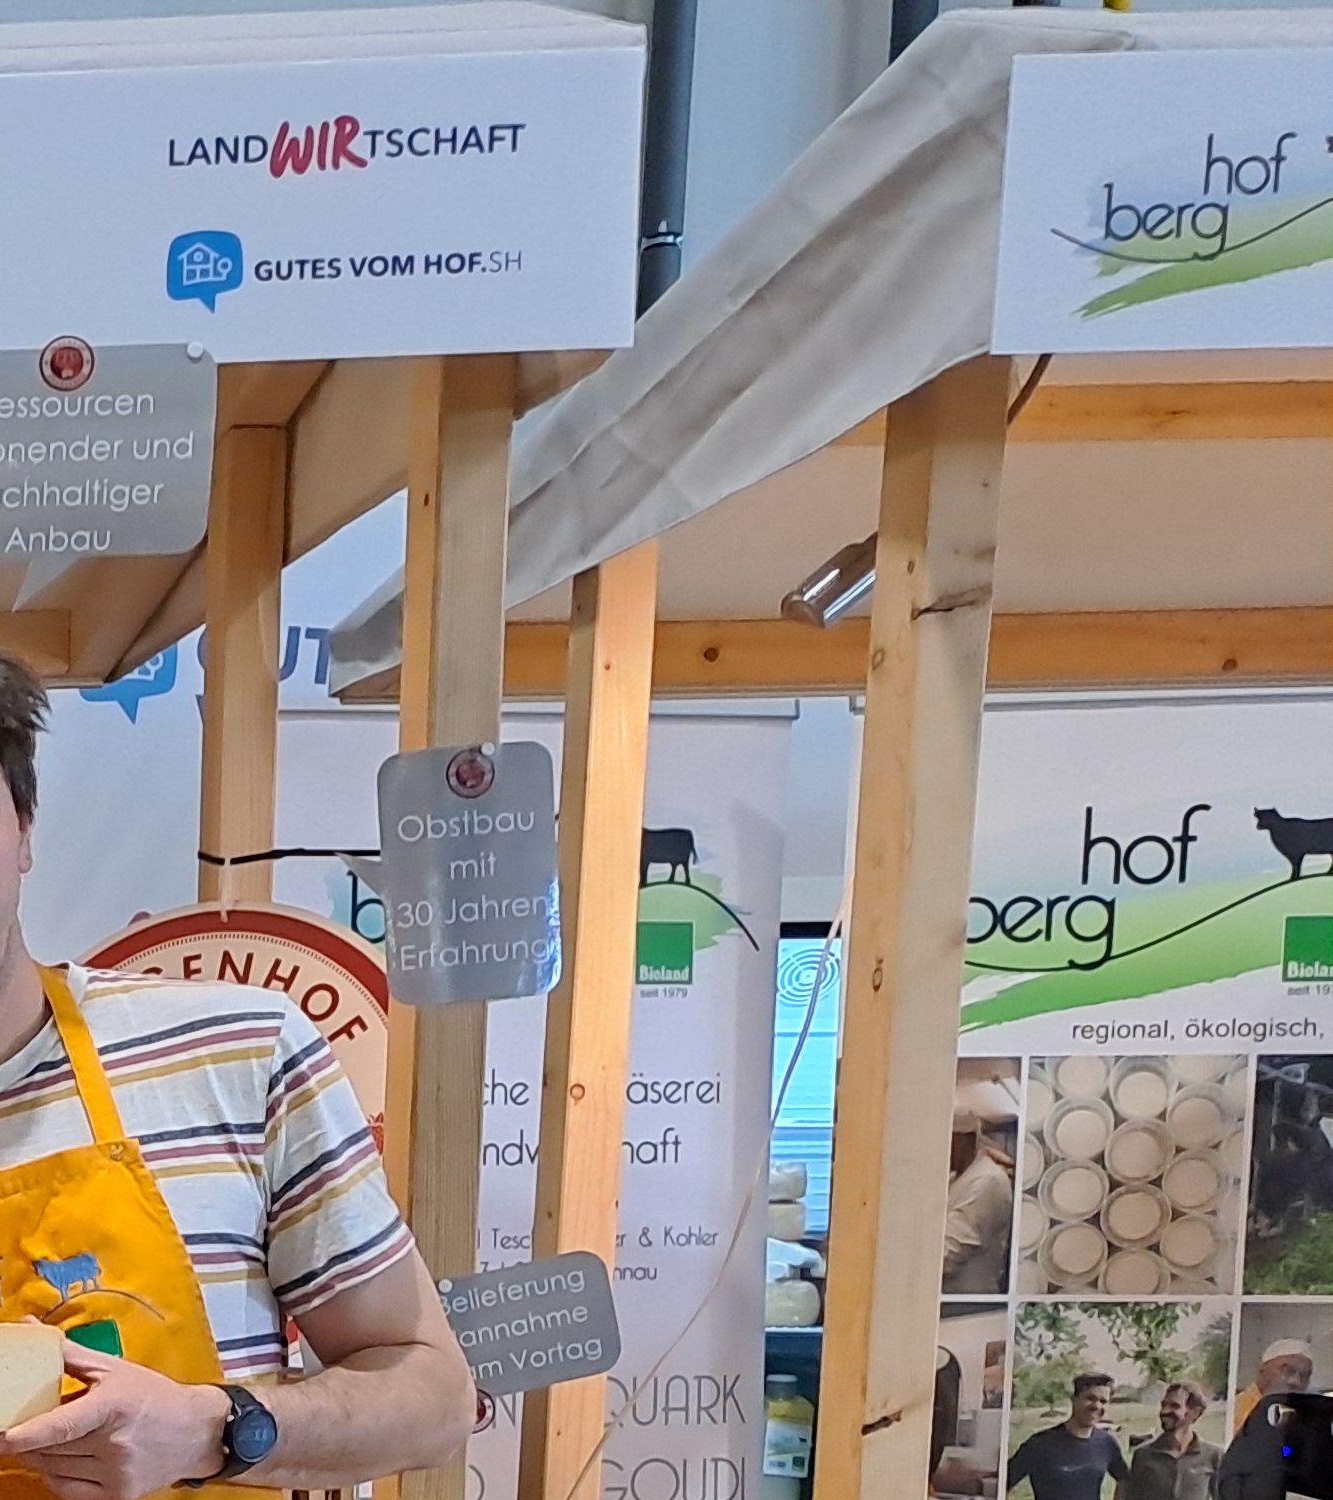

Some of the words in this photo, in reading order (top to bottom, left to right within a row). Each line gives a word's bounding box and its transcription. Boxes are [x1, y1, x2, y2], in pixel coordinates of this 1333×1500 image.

[169, 114, 526, 180] LANDWIRTSCHAFT
[1202, 131, 1298, 196] hof
[1103, 184, 1229, 262] berg
[254, 256, 342, 284] GUTES
[350, 253, 415, 279] VOM
[423, 249, 523, 276] HOF.SH
[131, 431, 194, 461] und
[5, 523, 112, 554] Anbau
[396, 809, 535, 843] Obstbau
[1081, 804, 1212, 885] hof
[450, 851, 498, 881] mit
[396, 902, 434, 929] 30
[444, 894, 550, 926] Jahren
[401, 938, 551, 971] Erfahrung
[639, 964, 690, 982] Bioland
[1071, 1020, 1176, 1045] regional,
[1185, 1016, 1325, 1043] ökologisch,
[638, 1226, 653, 1248] &
[663, 1225, 719, 1248] Kohler
[508, 1338, 603, 1371] Vortag
